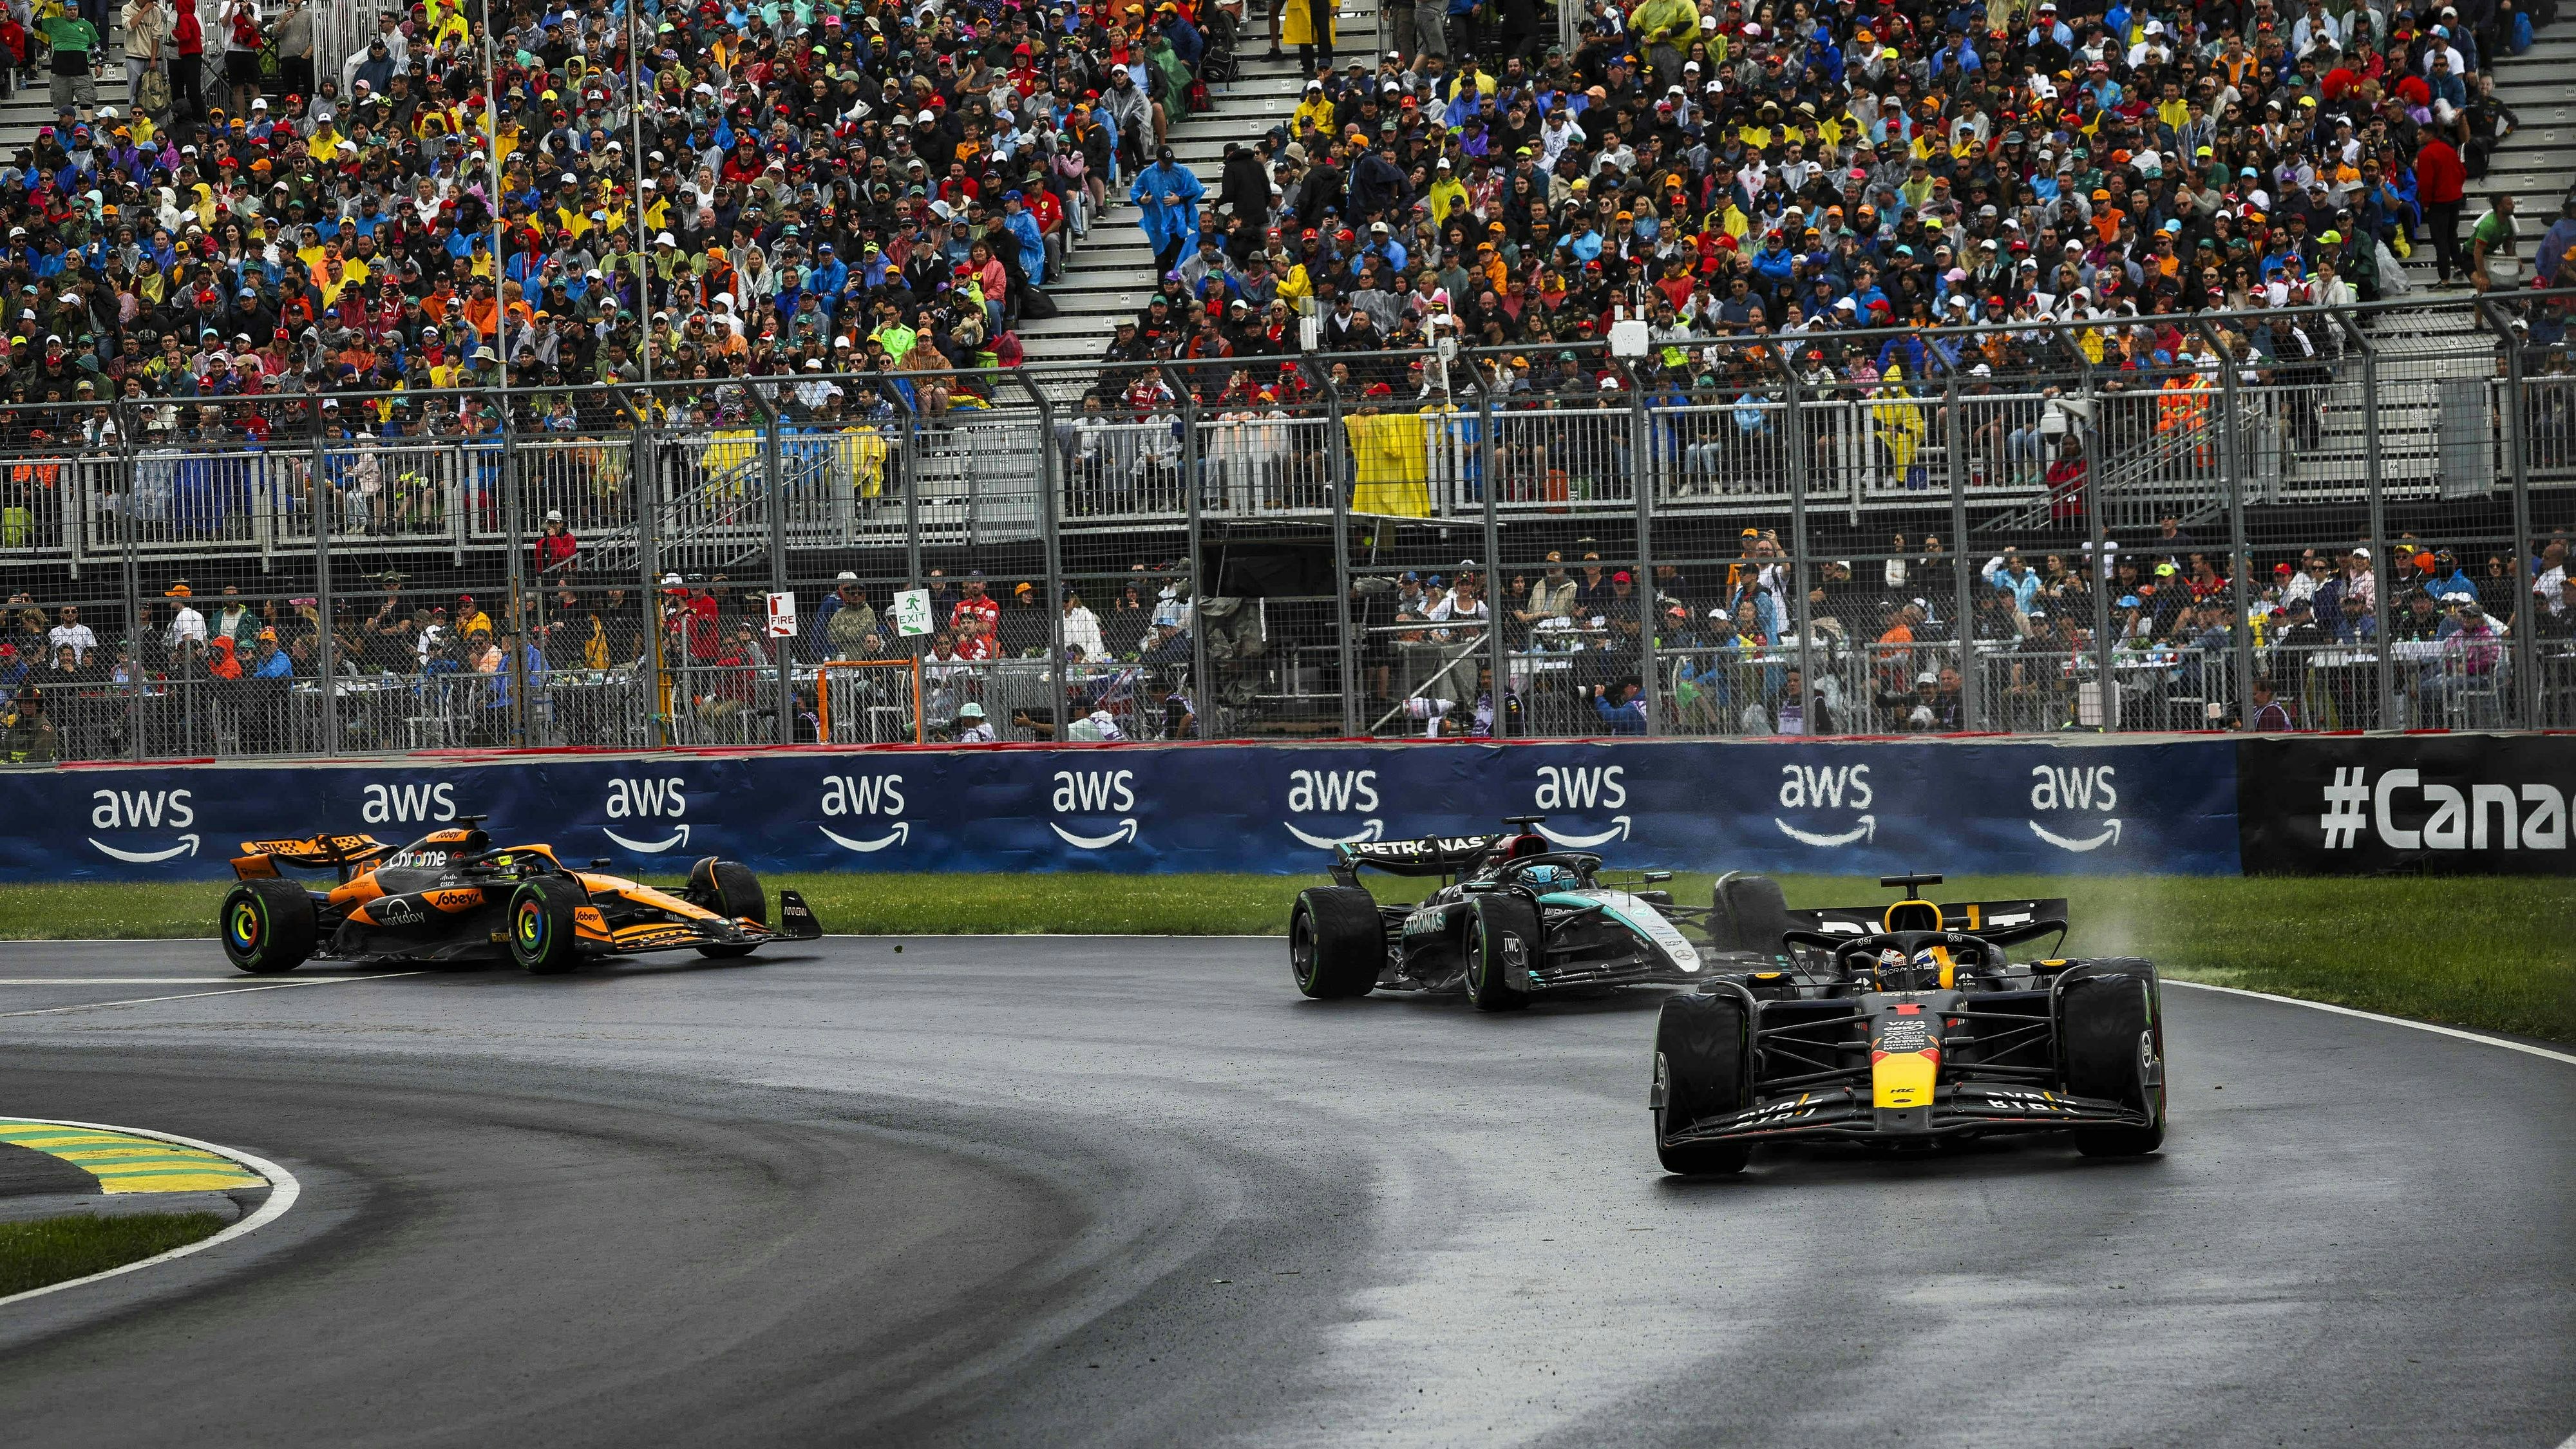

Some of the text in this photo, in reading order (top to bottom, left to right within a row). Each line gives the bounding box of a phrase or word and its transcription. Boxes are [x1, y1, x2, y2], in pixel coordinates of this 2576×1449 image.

[771, 615, 795, 625] FIRE
[899, 612, 926, 624] EXIT
[607, 778, 685, 817] aws
[822, 775, 904, 815] aws
[1054, 770, 1133, 811] aws
[1289, 770, 1378, 812] aws
[1535, 766, 1625, 809] aws
[1780, 764, 1873, 809] aws
[2031, 765, 2117, 811] aws
[93, 790, 193, 828] aws
[363, 783, 455, 823] aws
[2321, 766, 2576, 849] #Cana
[1358, 837, 1484, 855] PETRONAS
[389, 850, 447, 867] Chrome
[435, 892, 479, 905] Sobeys
[379, 911, 426, 925] workday
[575, 911, 599, 921] Sobeys
[1403, 913, 1446, 935] ETRONAS
[1504, 938, 1519, 952] IWC
[1888, 965, 1923, 975] ORALE
[1892, 958, 1904, 967] Red
